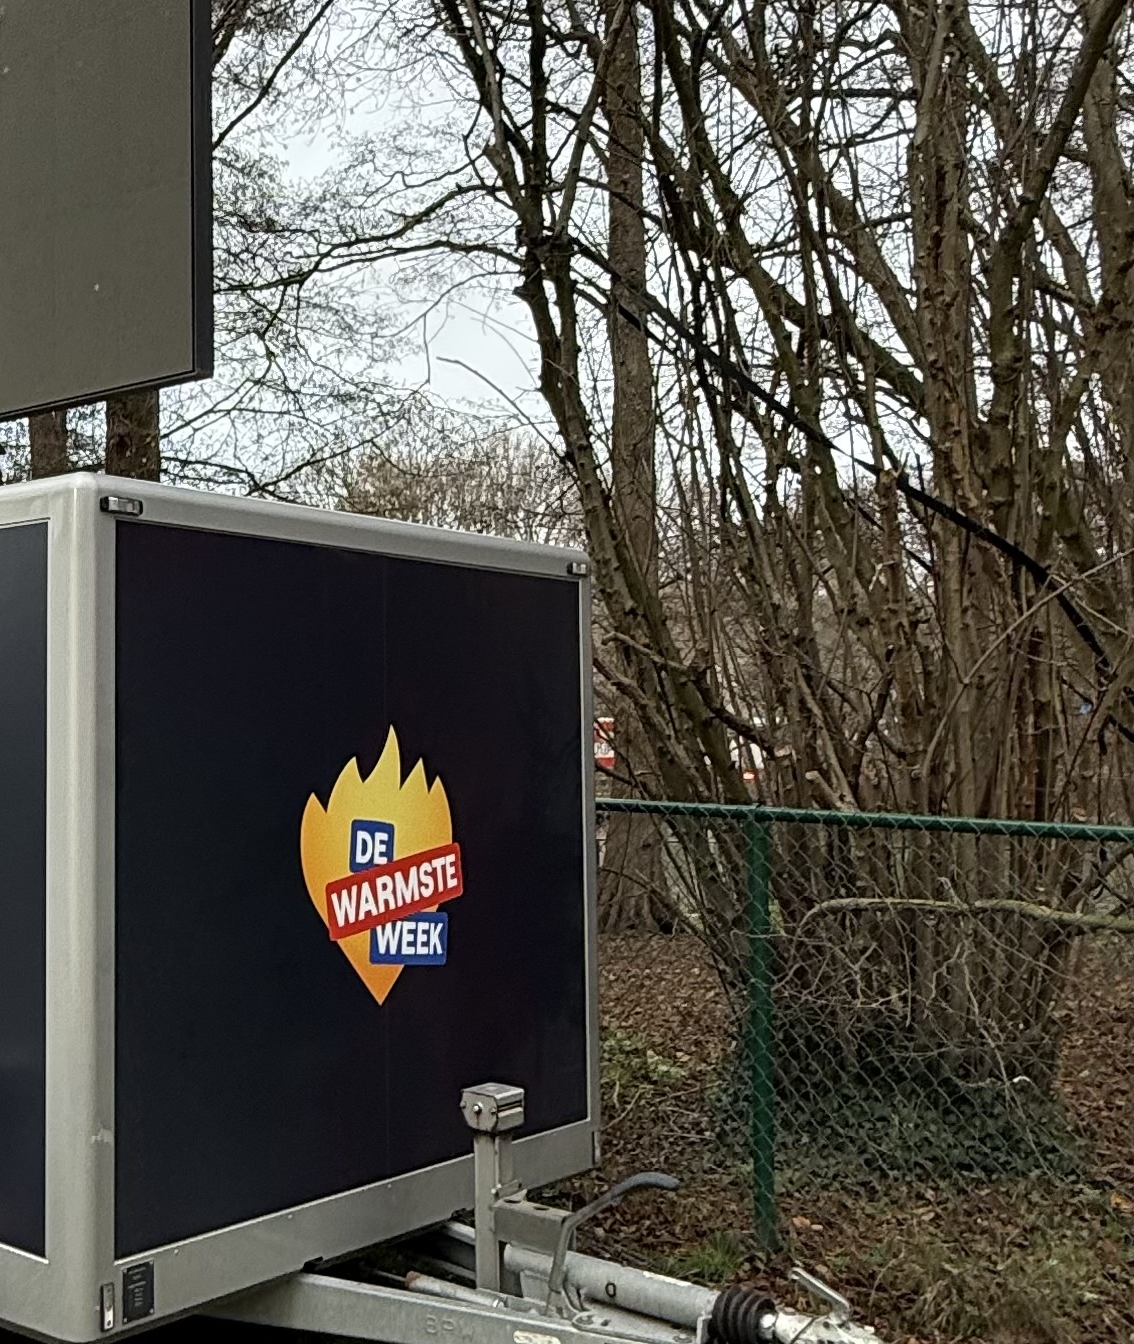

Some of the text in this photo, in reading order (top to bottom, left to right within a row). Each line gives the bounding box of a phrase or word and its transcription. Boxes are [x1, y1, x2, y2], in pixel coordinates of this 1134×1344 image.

[355, 830, 389, 866] DE
[330, 853, 459, 928] WARMSTE
[376, 920, 444, 955] WEEK
